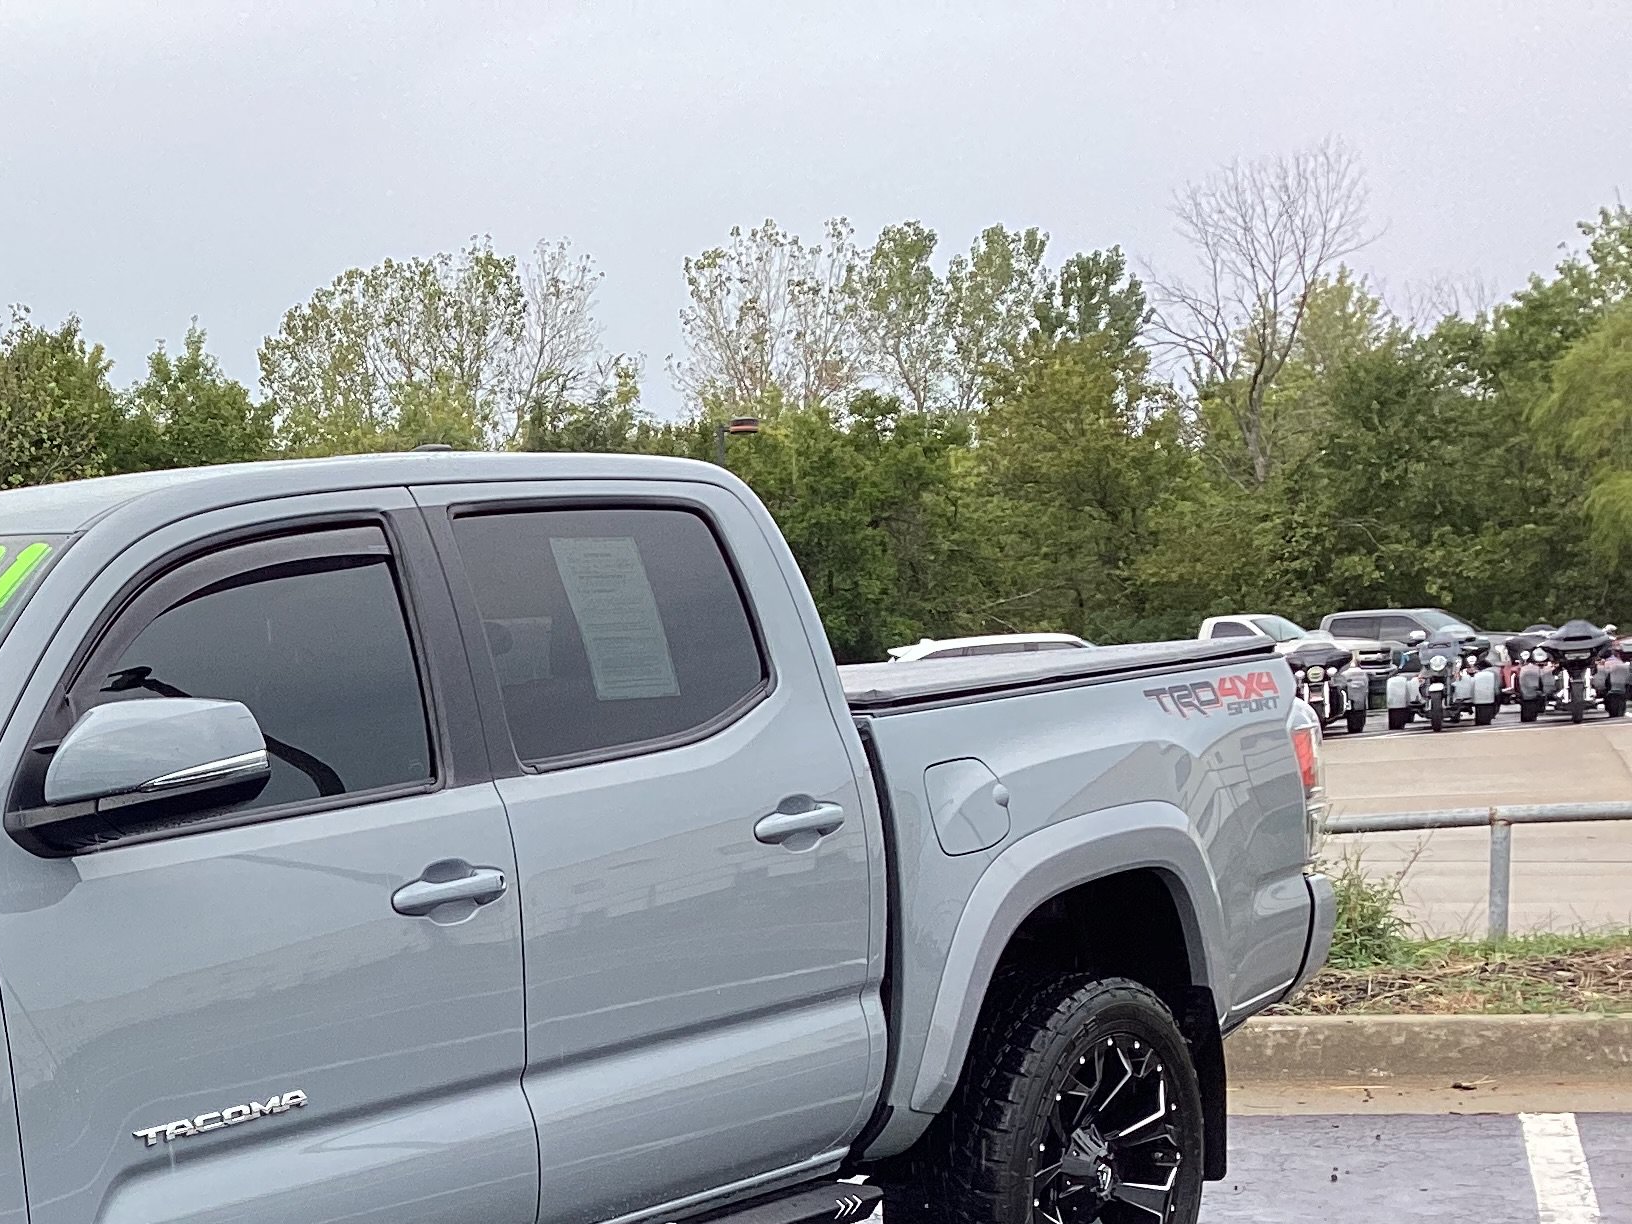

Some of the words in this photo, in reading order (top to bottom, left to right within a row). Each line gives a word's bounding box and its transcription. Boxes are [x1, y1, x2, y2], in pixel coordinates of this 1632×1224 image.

[1142, 680, 1224, 720] TRD
[1226, 695, 1280, 716] SPORT
[132, 1088, 309, 1147] TACOMA
